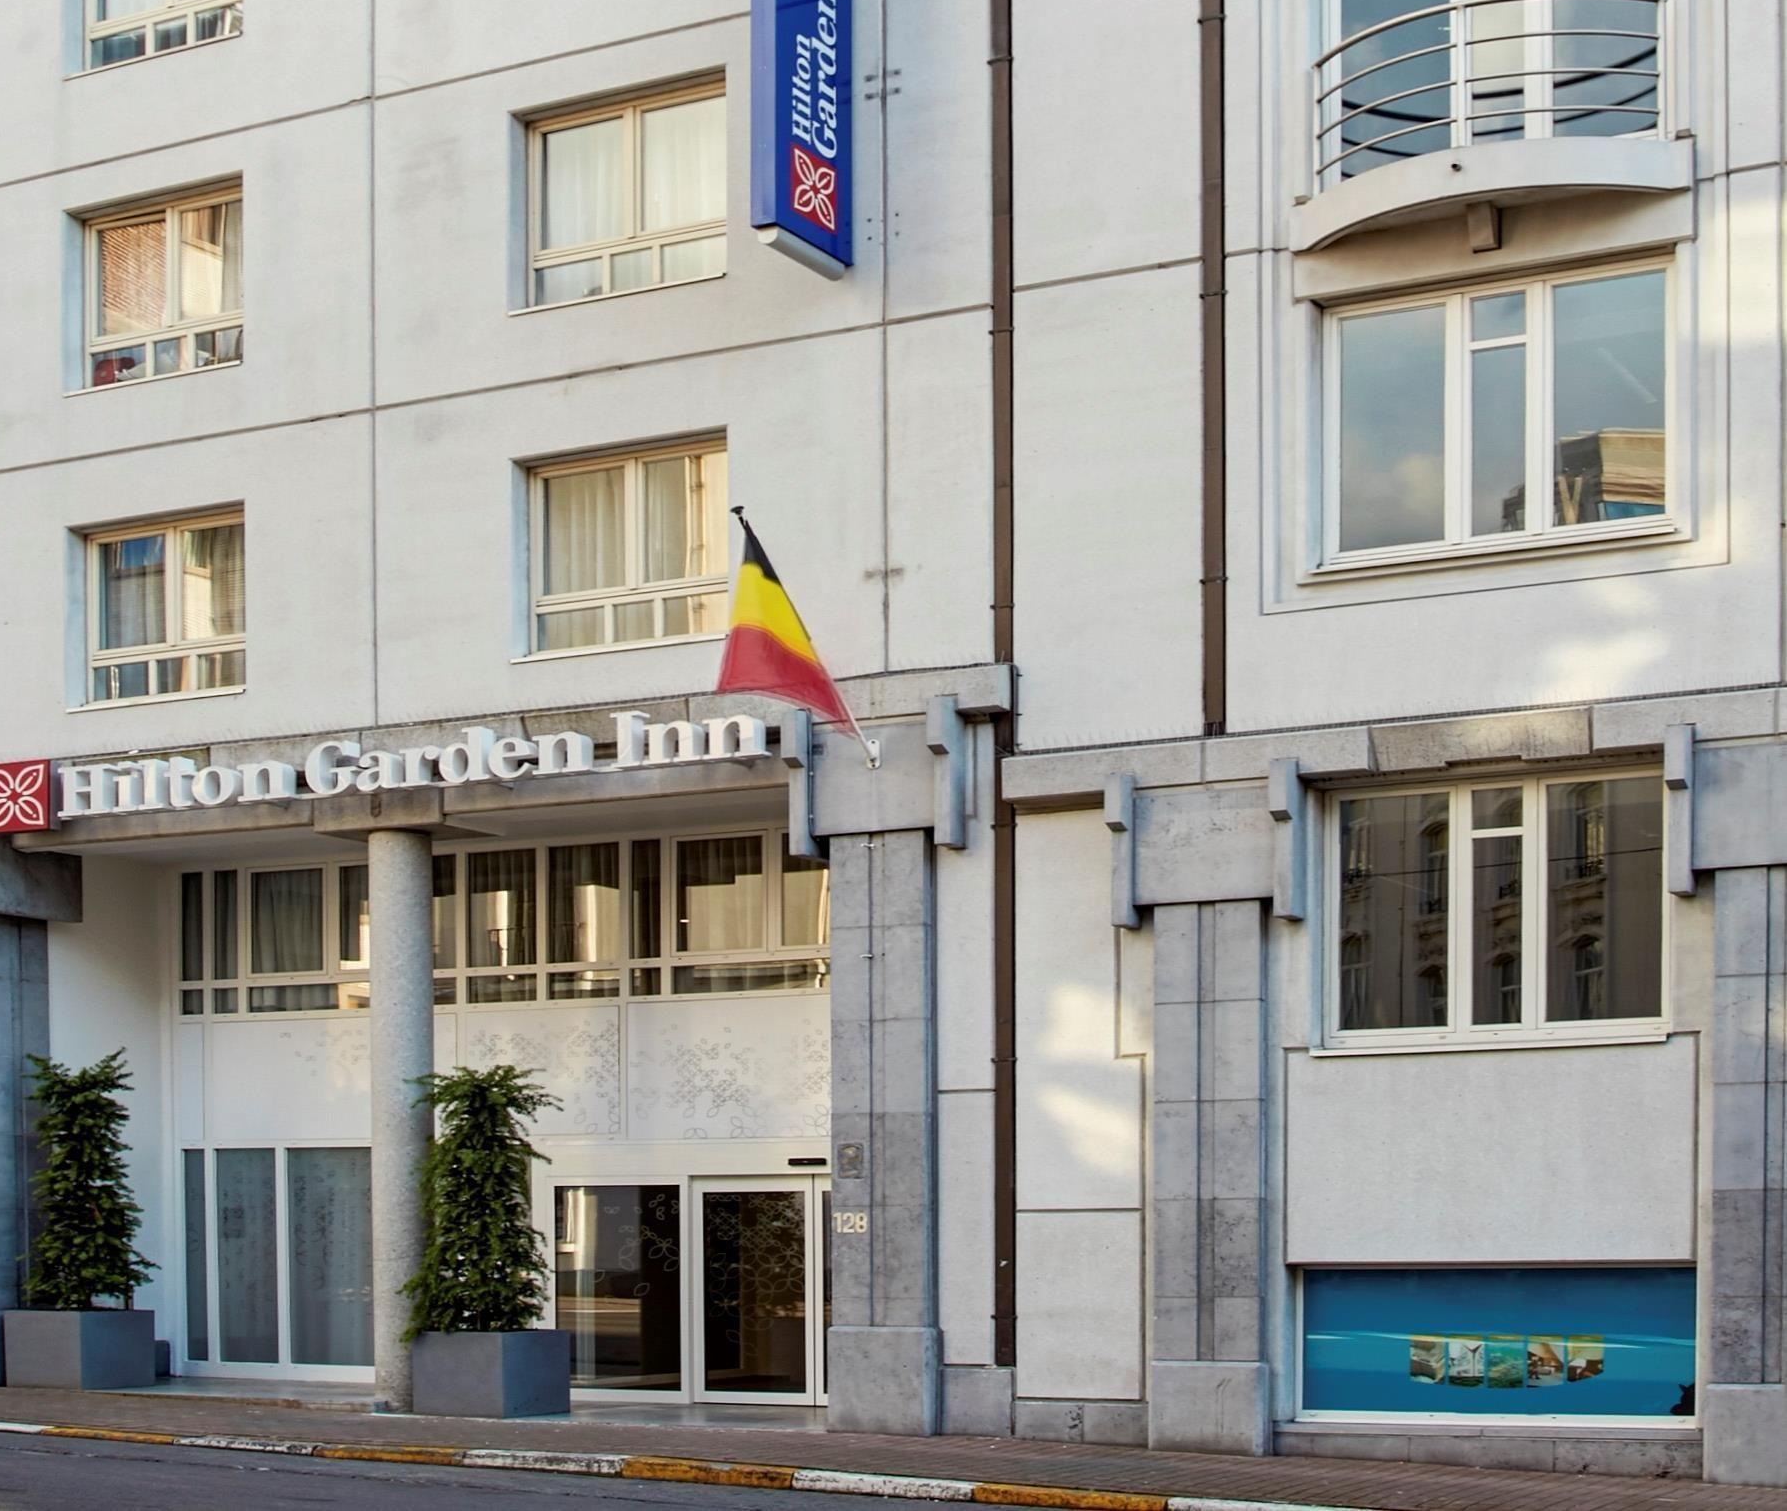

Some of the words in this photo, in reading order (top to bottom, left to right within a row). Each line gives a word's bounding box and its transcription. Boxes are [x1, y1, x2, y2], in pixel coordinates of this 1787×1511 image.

[791, 34, 813, 145] Hilton
[57, 756, 297, 819] Hilton
[304, 725, 595, 795] Garden
[610, 710, 767, 768] Inn
[832, 1211, 868, 1234] 128
